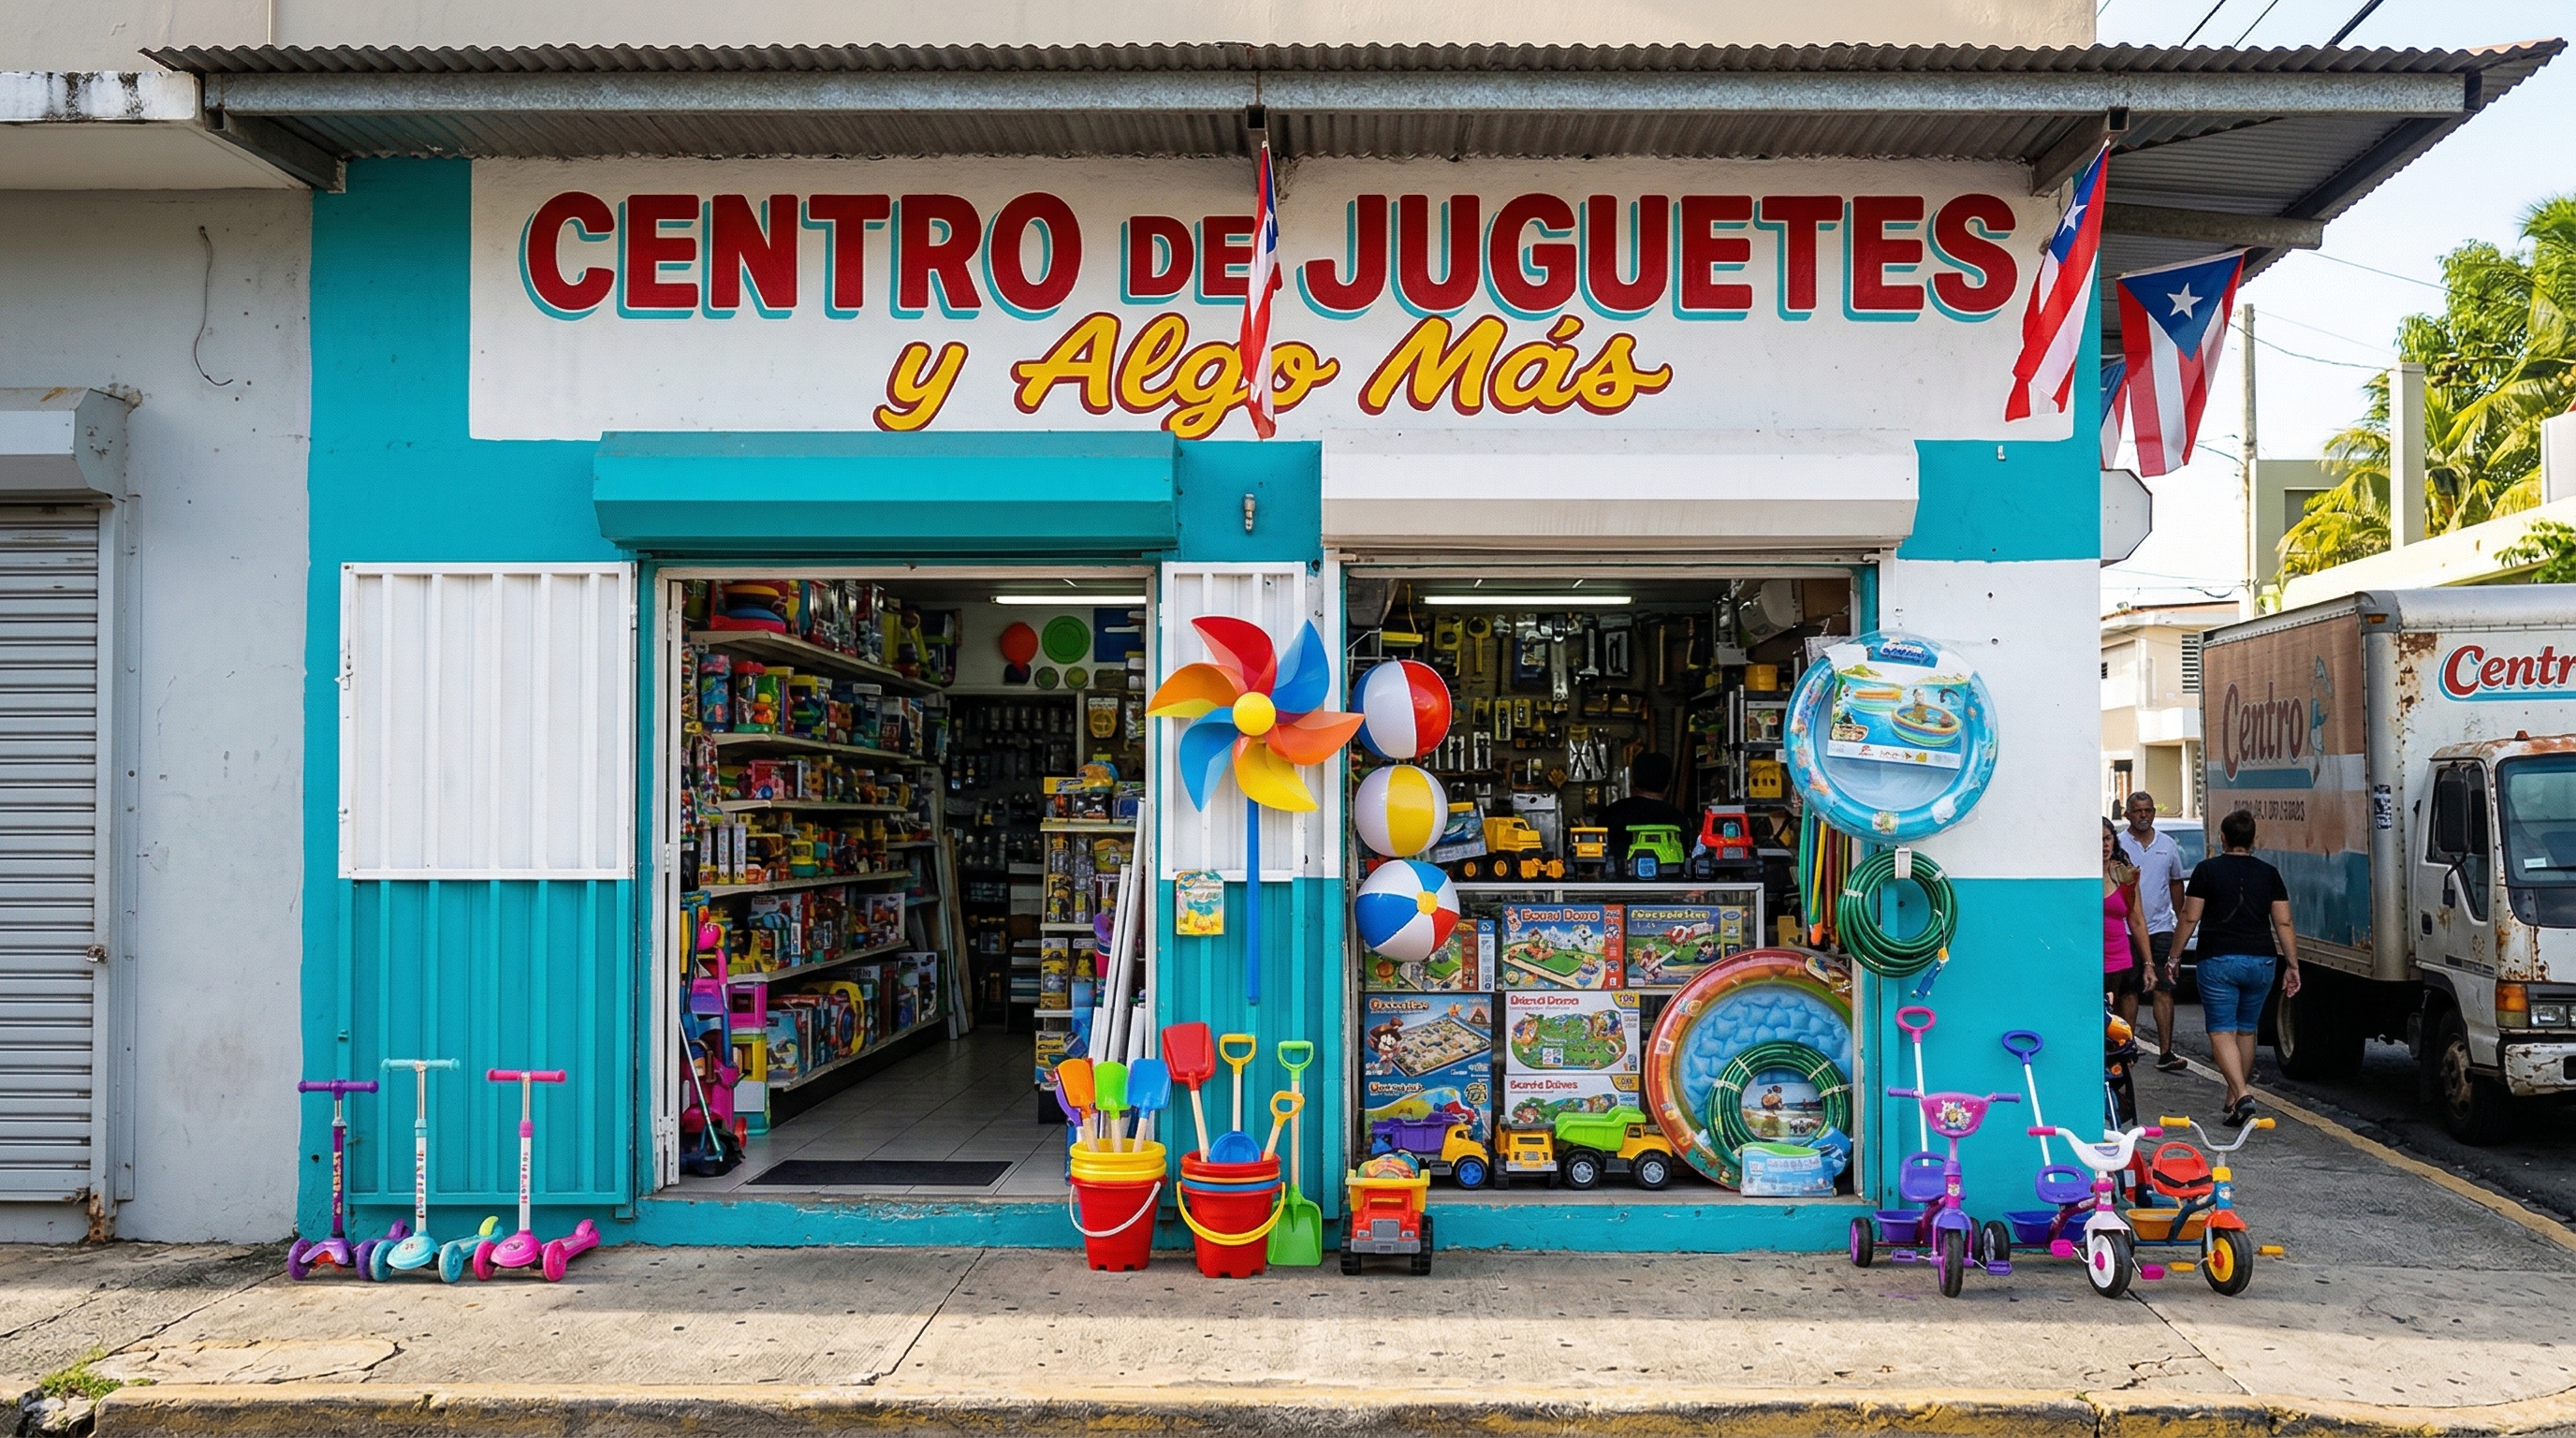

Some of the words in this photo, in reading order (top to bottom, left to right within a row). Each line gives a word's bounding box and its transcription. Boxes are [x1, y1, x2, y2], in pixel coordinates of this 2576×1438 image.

[520, 191, 1082, 320] CENTRO
[1120, 215, 1255, 305] DE
[1296, 193, 2018, 323] JUGUETES
[872, 340, 969, 432] y
[1010, 312, 1340, 440] Algo
[1358, 313, 1672, 417] Más
[2440, 644, 2576, 698] Centr
[2222, 682, 2305, 782] Centro
